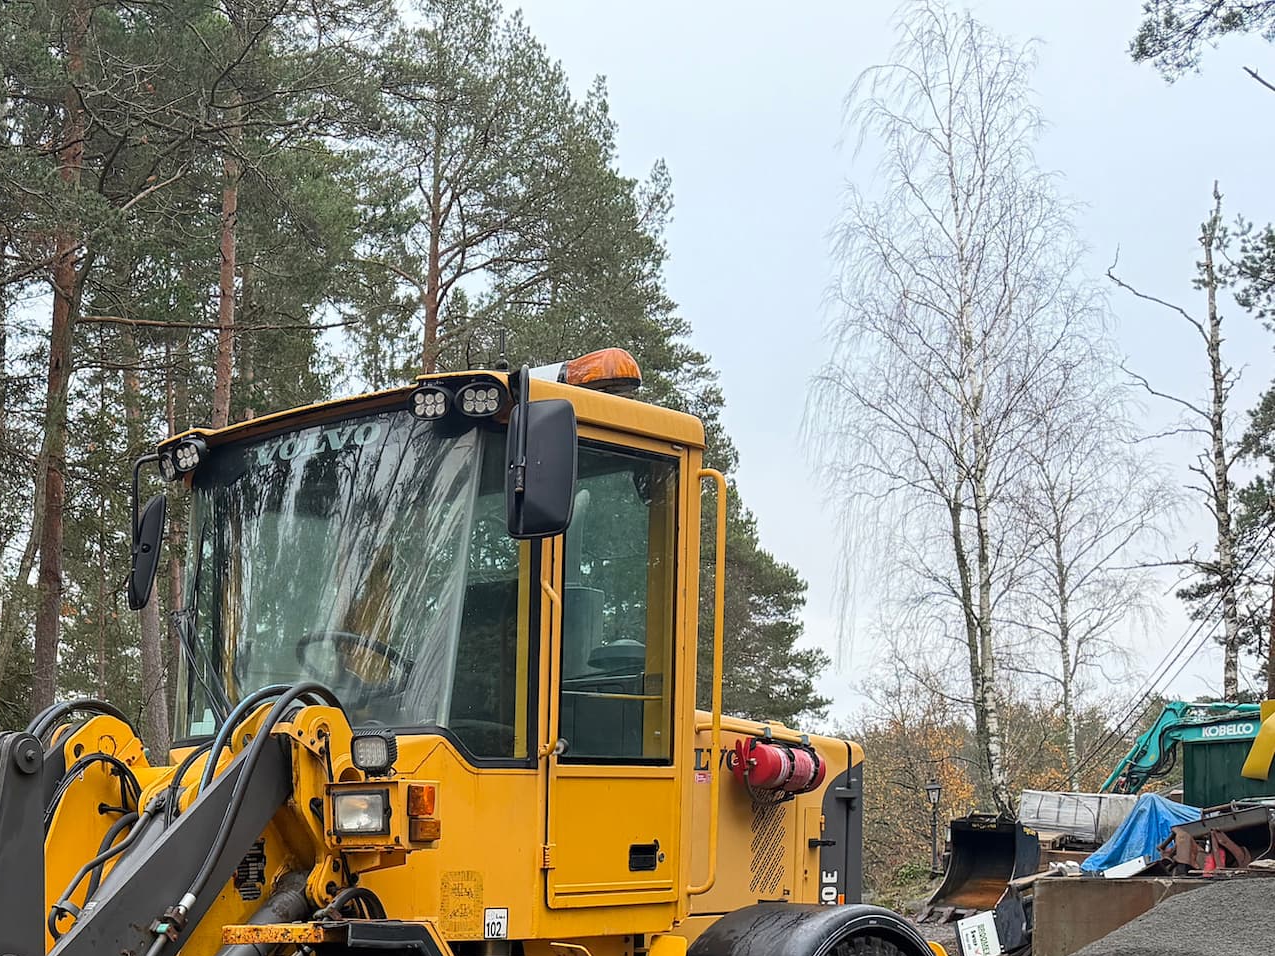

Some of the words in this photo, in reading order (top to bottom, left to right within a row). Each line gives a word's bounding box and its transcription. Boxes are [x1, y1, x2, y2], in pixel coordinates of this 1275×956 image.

[253, 422, 381, 466] VOLVO
[1201, 722, 1254, 738] KOBELCO
[486, 921, 502, 937] 102
